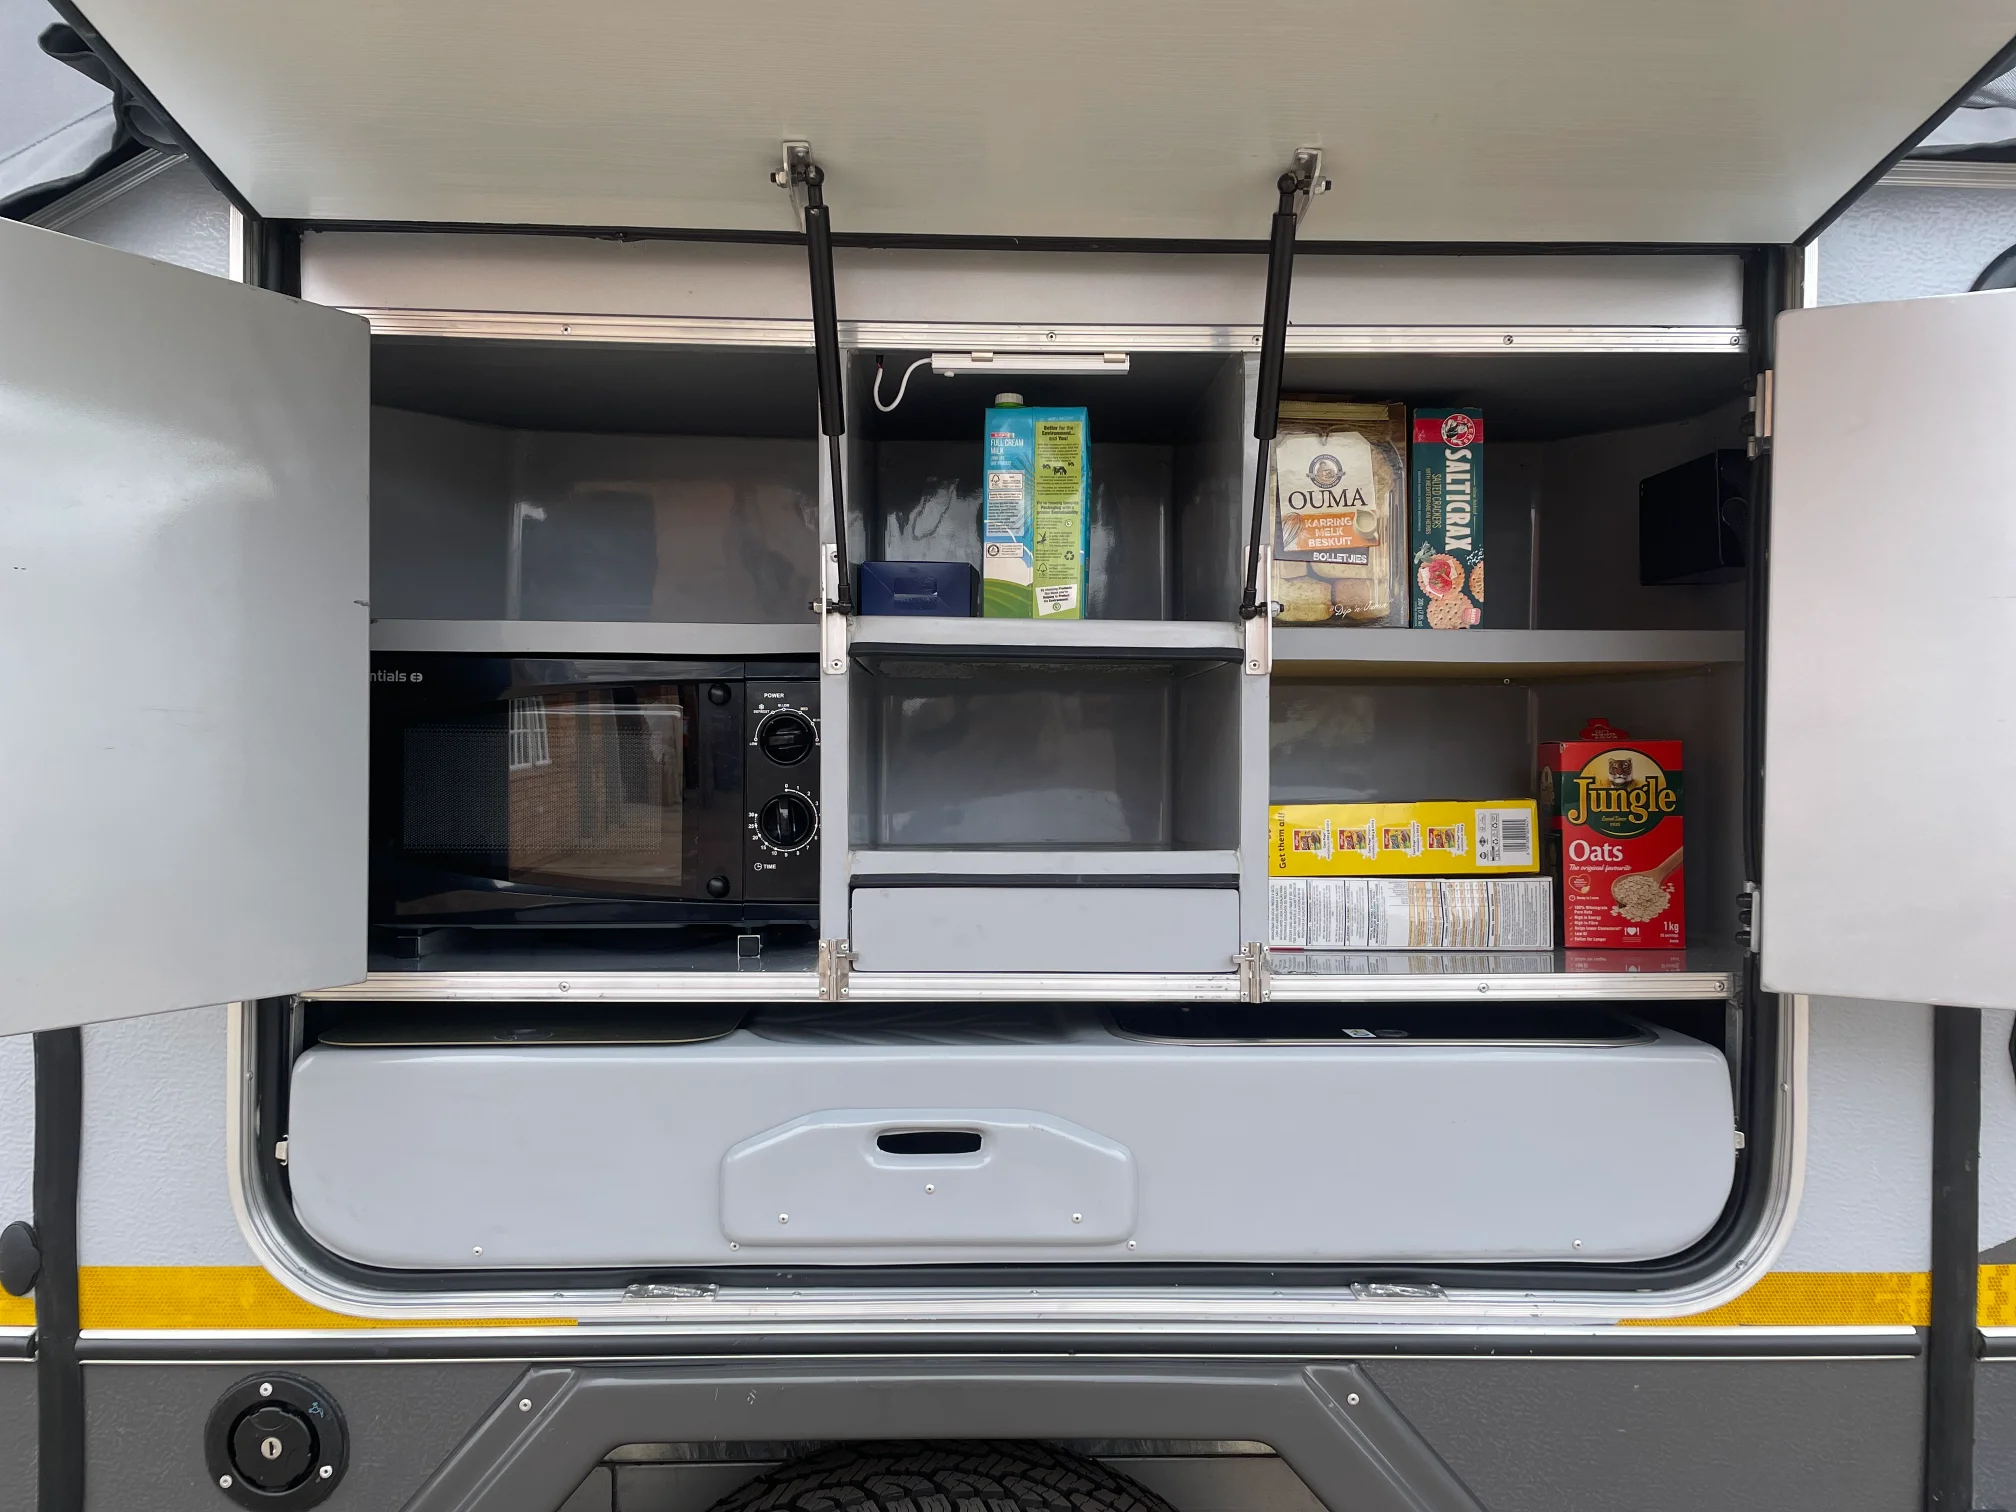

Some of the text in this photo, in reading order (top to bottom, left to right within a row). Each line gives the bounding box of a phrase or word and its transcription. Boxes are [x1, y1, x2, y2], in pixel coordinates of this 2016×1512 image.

[1288, 487, 1368, 510] OUMA
[1432, 473, 1442, 529] SALTED CRACKERS
[1445, 448, 1472, 551] SALTICRAX
[1305, 517, 1353, 528] KARRING
[1315, 527, 1344, 537] MELK
[1308, 537, 1353, 547] BESKUIT
[1313, 552, 1367, 564] BOLLETJIES
[370, 670, 407, 682] ntials
[1568, 778, 1677, 825] Jungle
[1569, 840, 1623, 861] Oats
[1580, 864, 1604, 872] original
[1604, 864, 1632, 872] favourite
